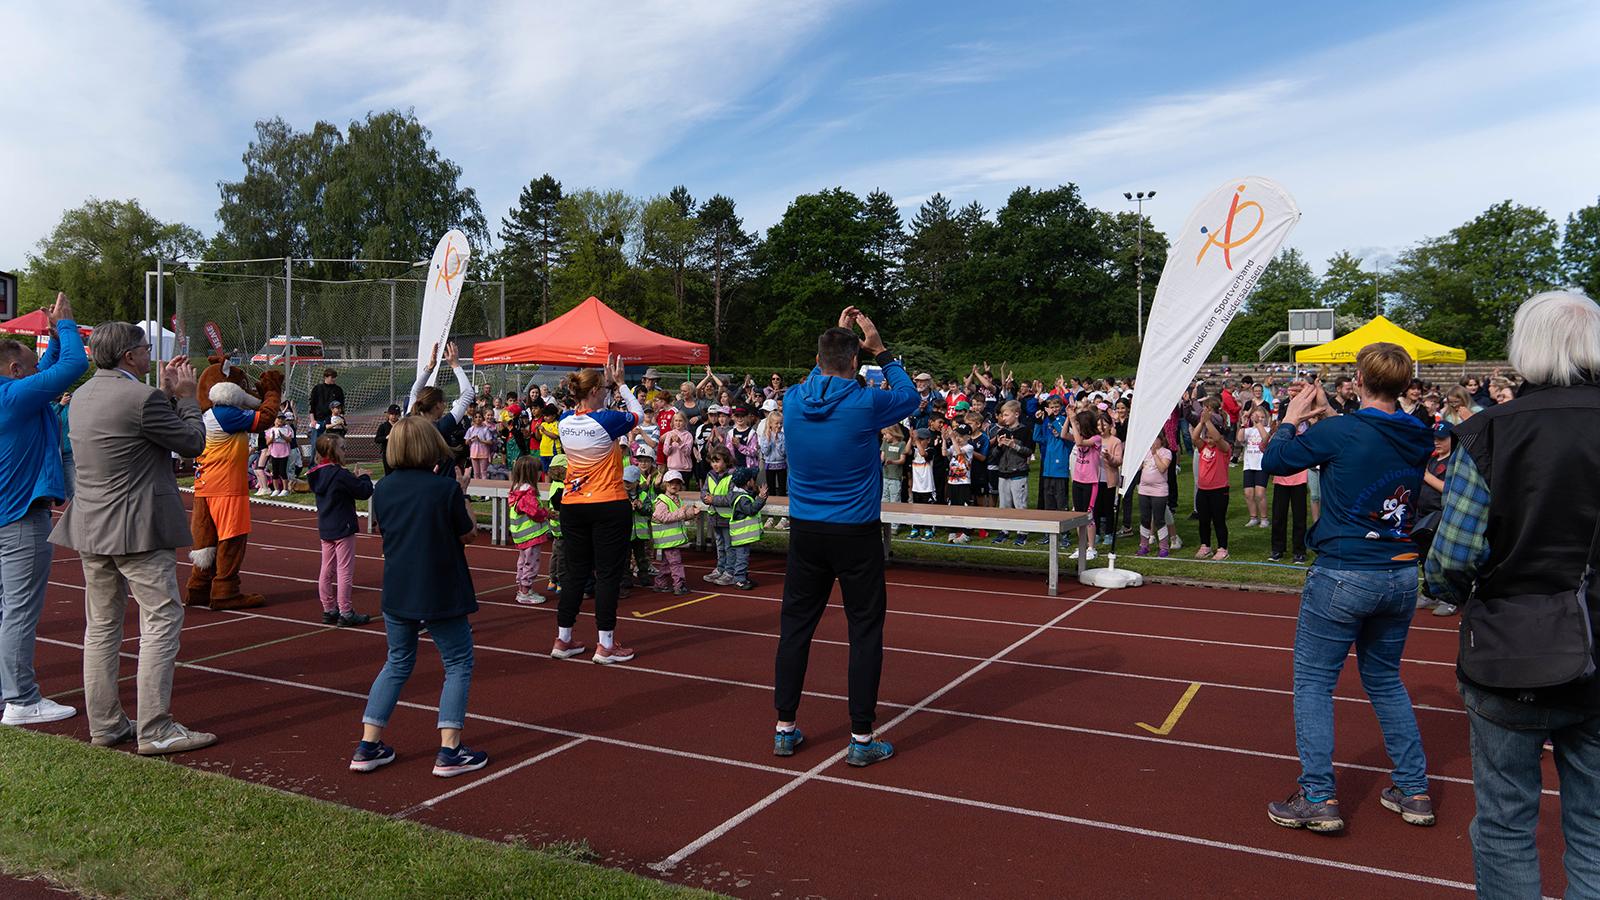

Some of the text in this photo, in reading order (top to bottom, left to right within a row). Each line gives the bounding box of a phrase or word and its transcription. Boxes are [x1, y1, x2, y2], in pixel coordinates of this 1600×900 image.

[1182, 259, 1255, 365] Behinderten Sportverband
[1220, 264, 1264, 325] Niedersachsen
[1331, 350, 1358, 360] gasu
